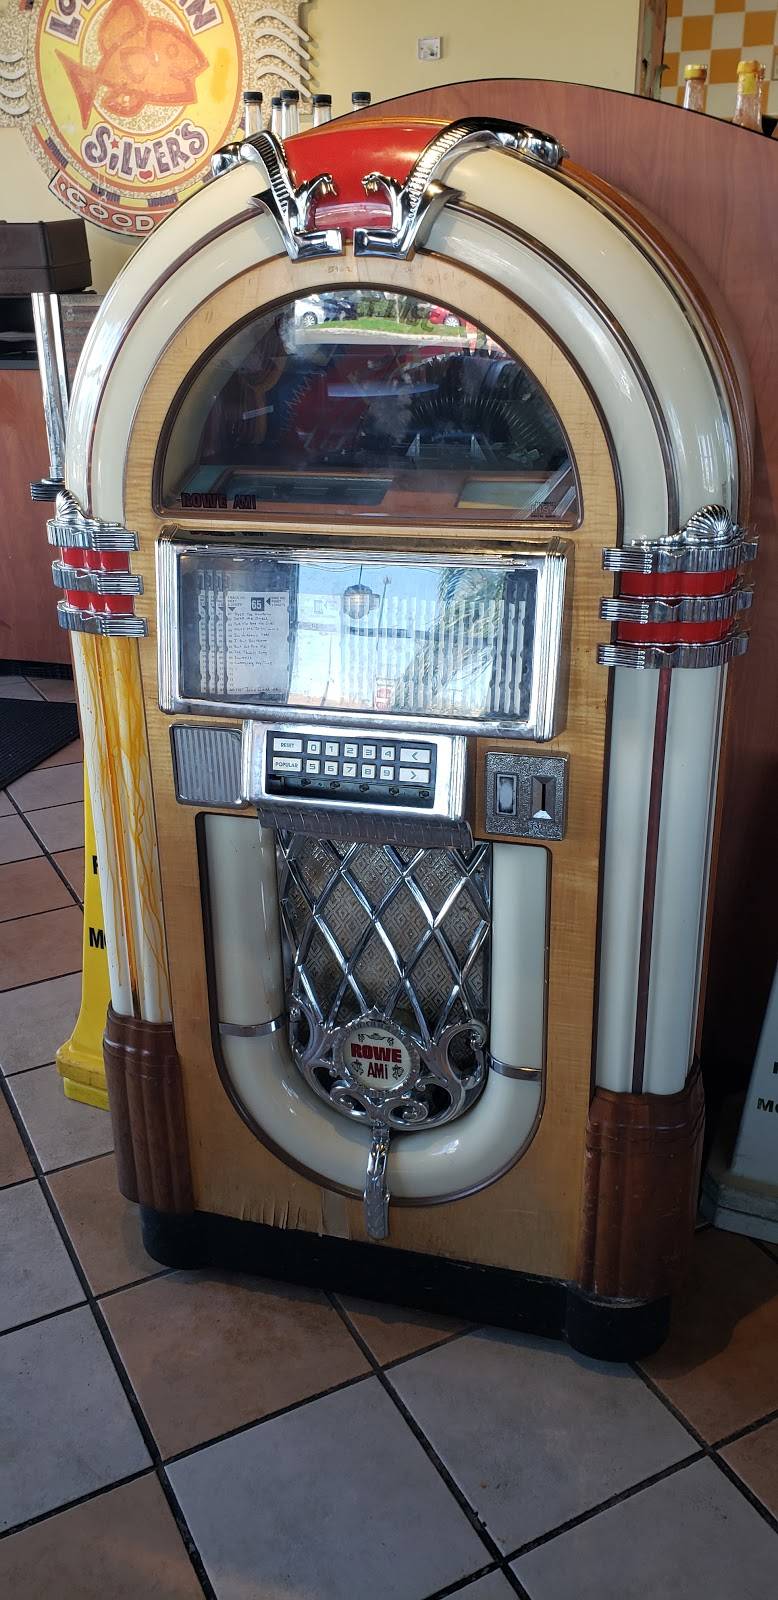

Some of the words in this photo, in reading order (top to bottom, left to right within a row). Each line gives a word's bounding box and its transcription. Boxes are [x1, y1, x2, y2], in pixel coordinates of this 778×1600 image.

[66, 187, 155, 231] GOOD
[181, 493, 227, 508] ROWE
[252, 599, 262, 609] 65
[346, 766, 353, 774] 7
[351, 1043, 402, 1064] ROWE
